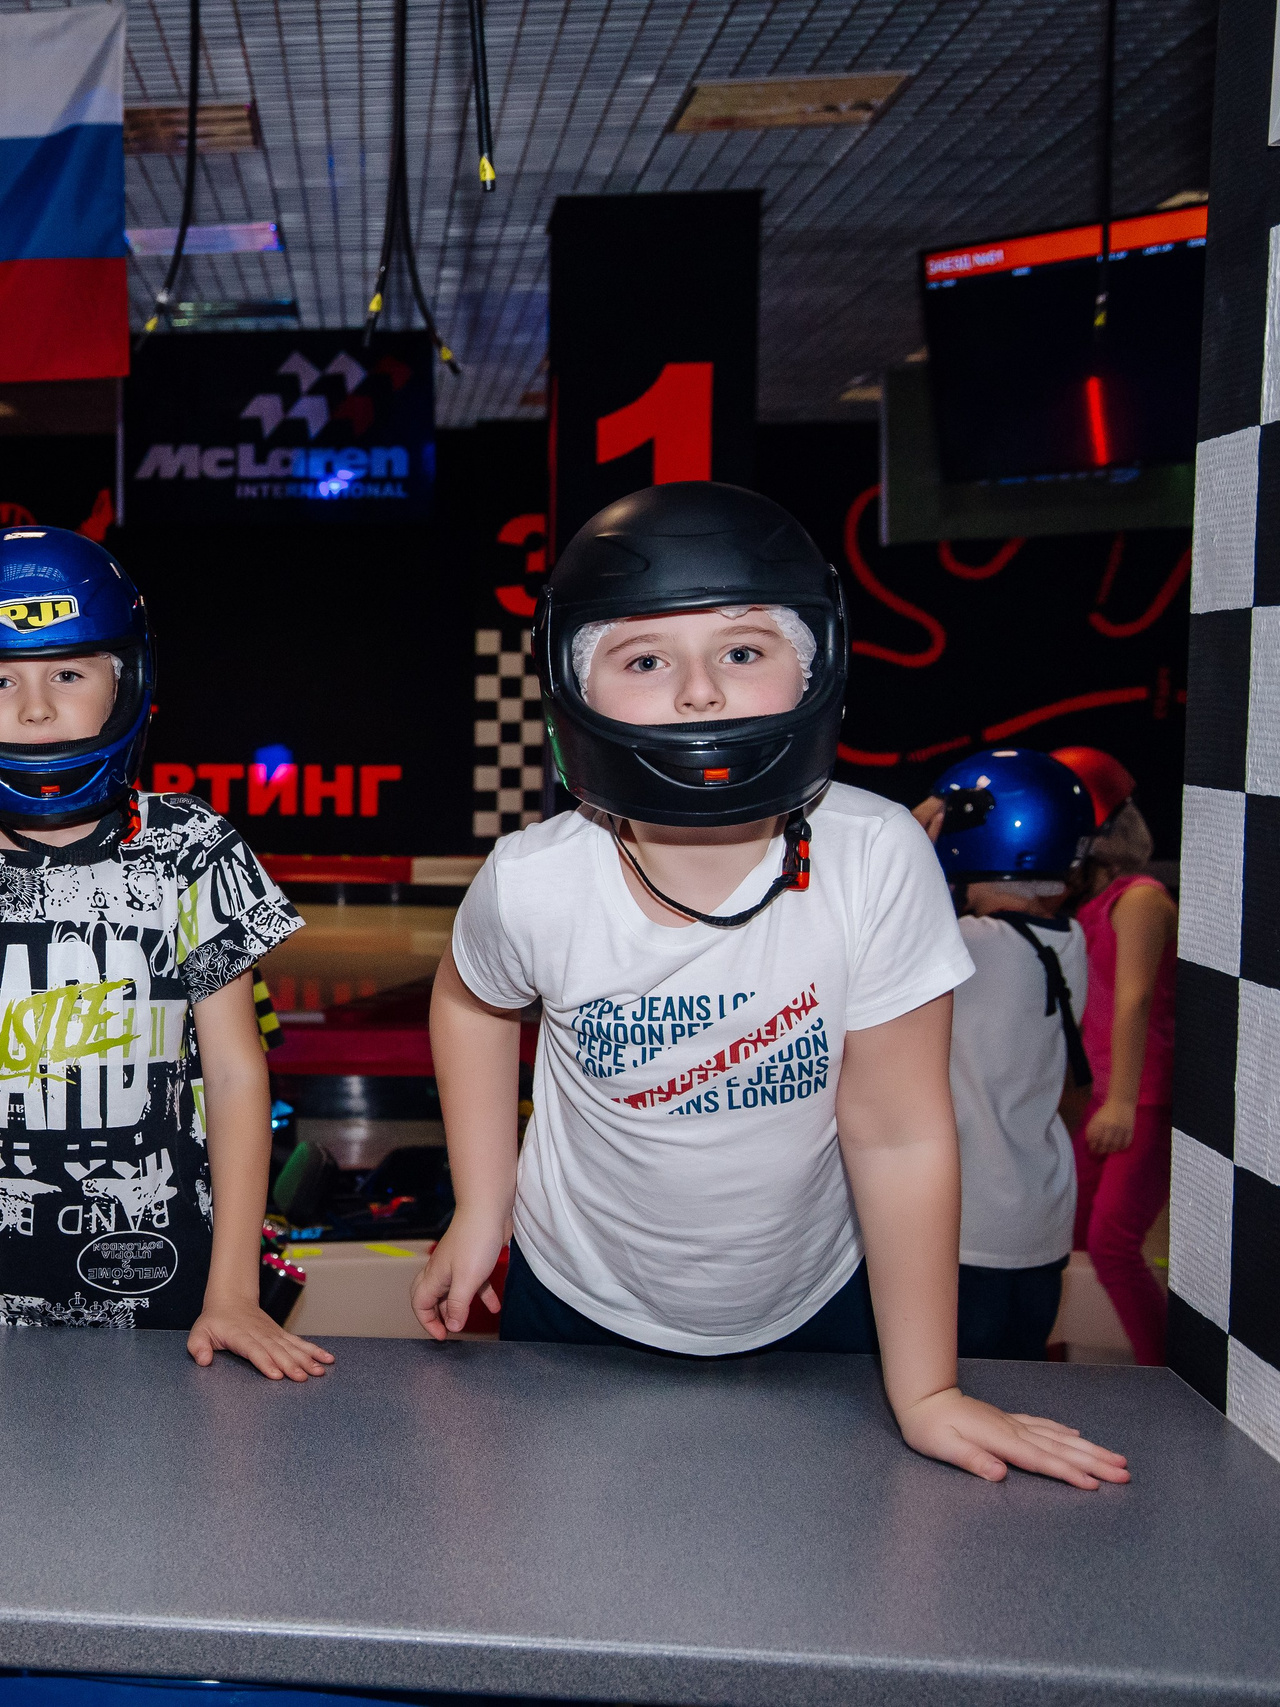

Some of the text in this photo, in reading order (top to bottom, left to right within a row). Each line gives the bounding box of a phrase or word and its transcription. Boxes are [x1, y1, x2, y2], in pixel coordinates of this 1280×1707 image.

[135, 444, 410, 480] McLaren
[235, 482, 408, 499] INTERNIONAL
[0, 601, 71, 627] PJ1
[132, 763, 402, 817] РТИНГ
[631, 994, 712, 1022] JEANS
[577, 1031, 627, 1067] PEPE
[747, 1055, 830, 1086] JEANS
[728, 1072, 828, 1111] LONDON
[102, 1250, 152, 1260] UTOPIA
[121, 1259, 131, 1268] 2
[88, 1266, 168, 1279] WELCOME
